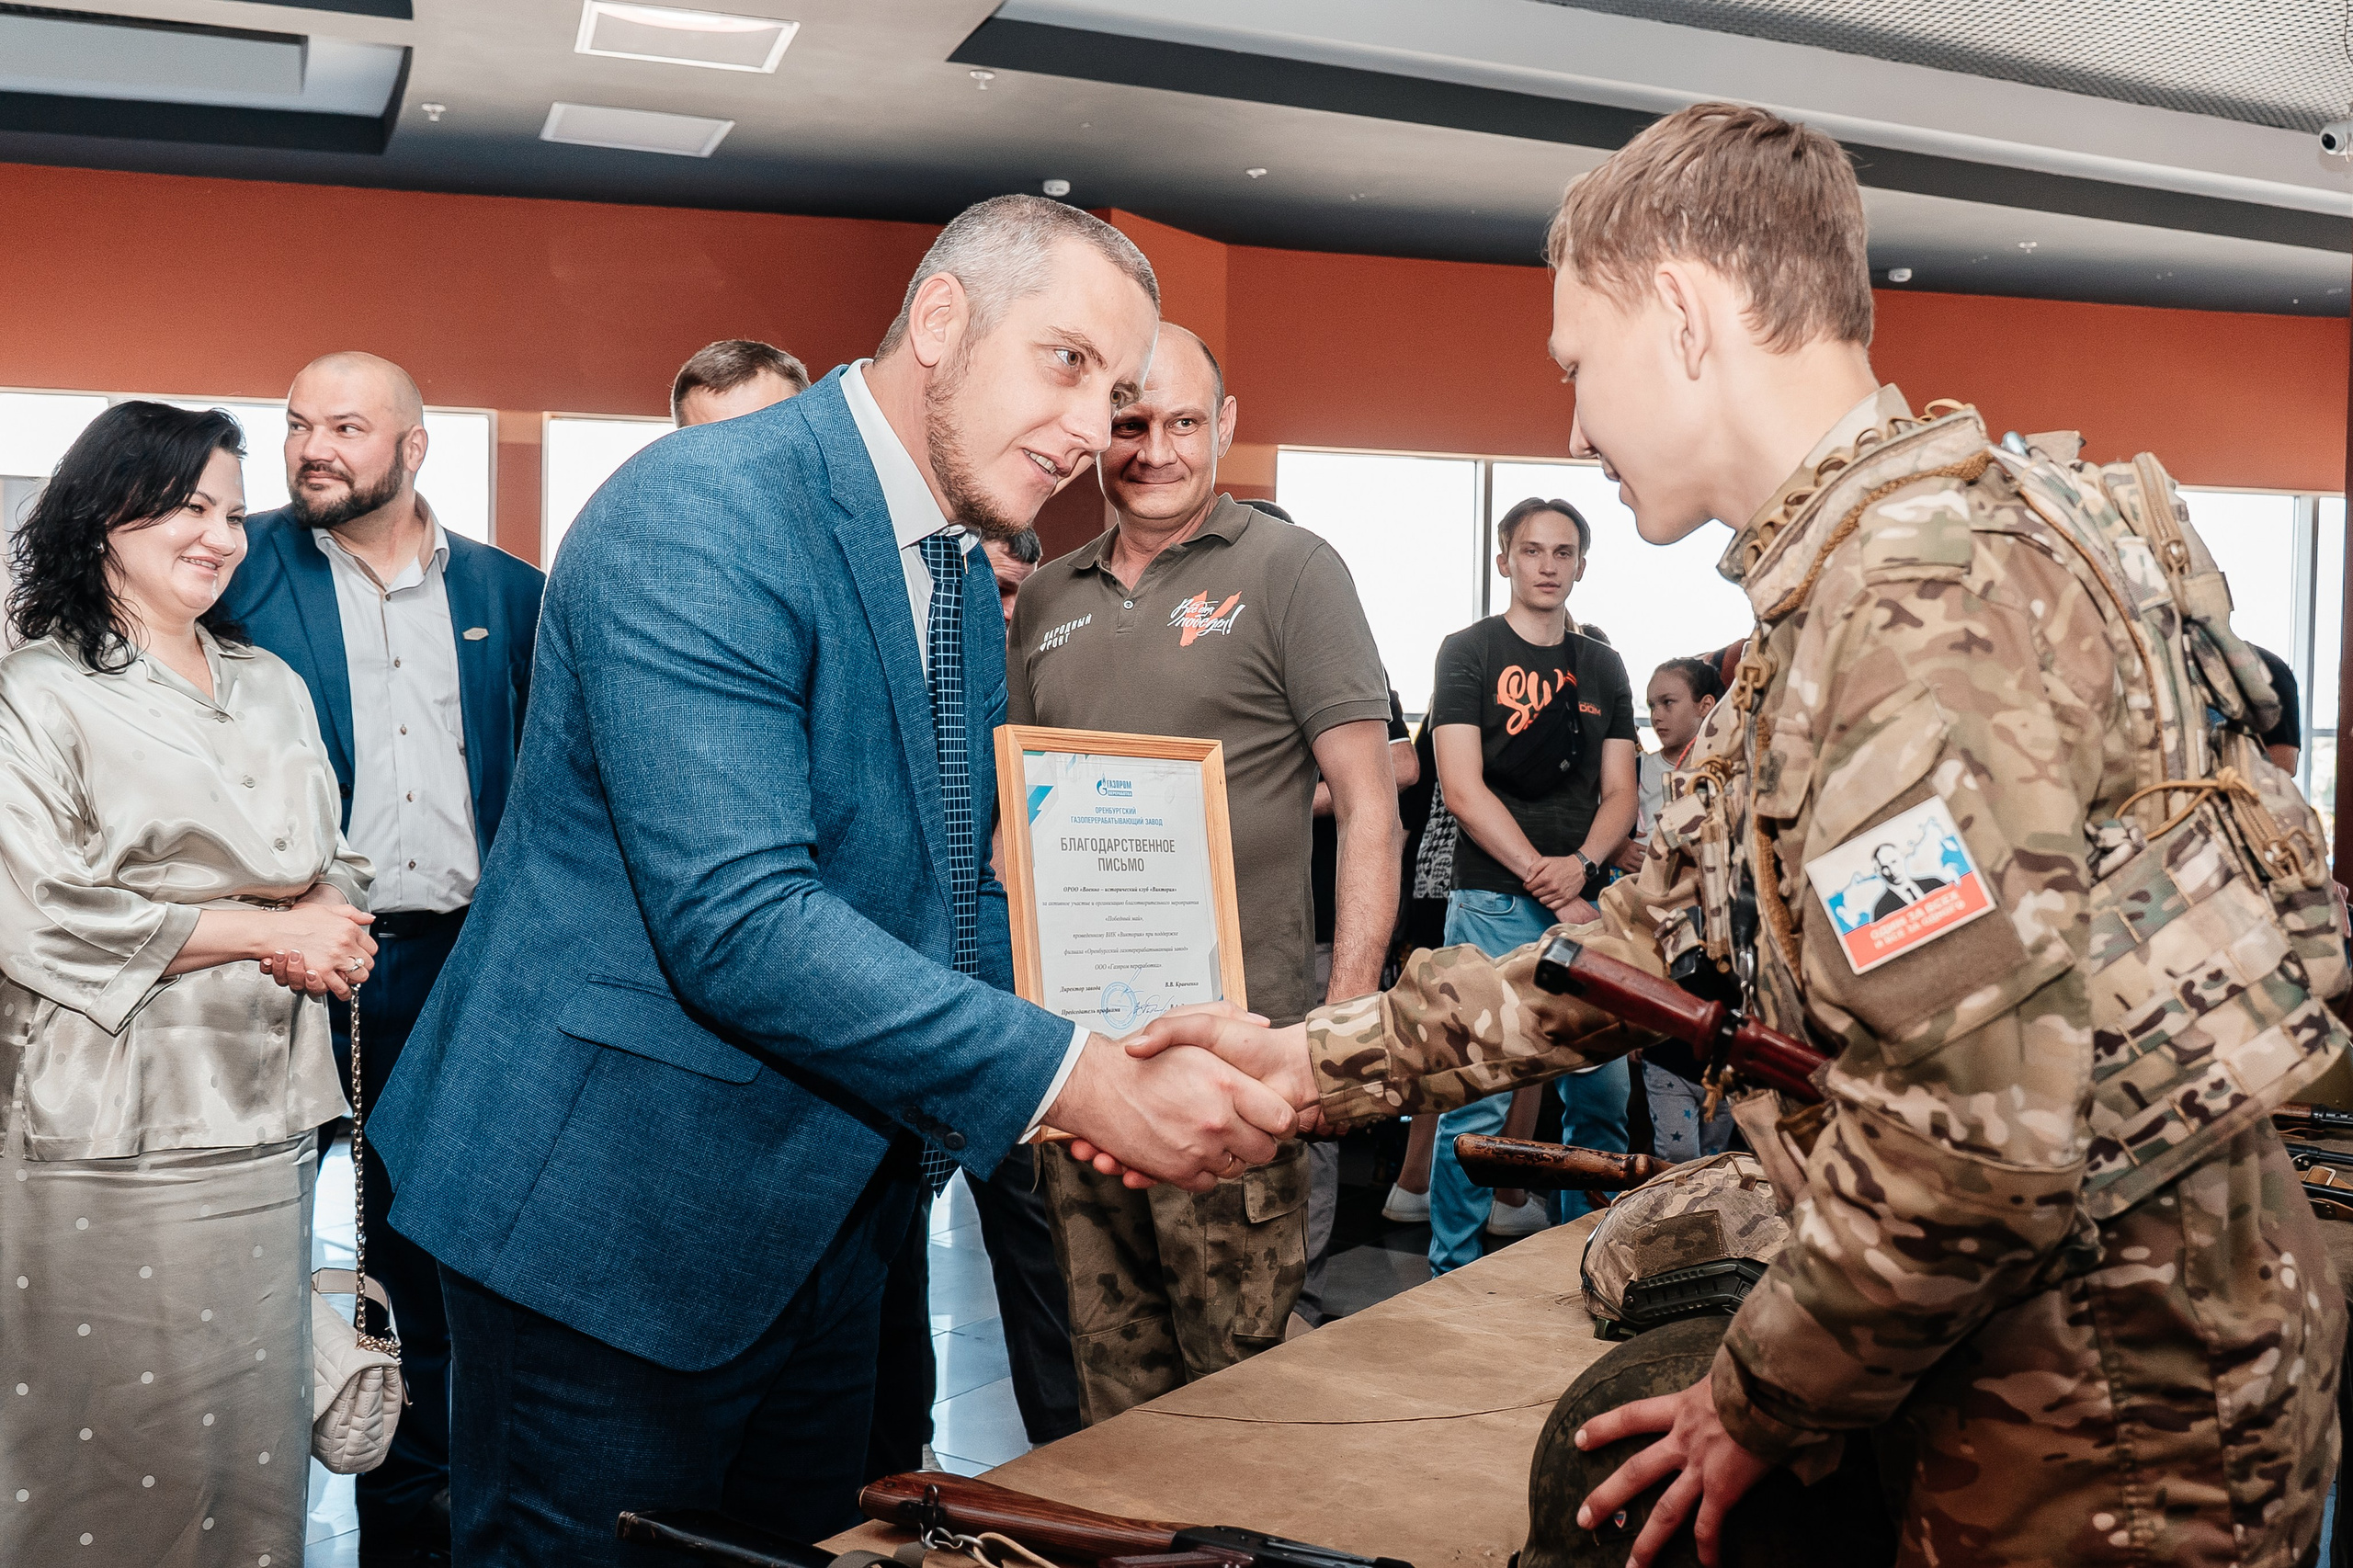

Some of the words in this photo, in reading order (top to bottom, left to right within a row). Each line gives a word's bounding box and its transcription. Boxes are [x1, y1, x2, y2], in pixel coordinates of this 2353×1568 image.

[1043, 613, 1092, 642] НАРОДНЫЙ
[1040, 632, 1070, 652] ФРОНТ
[1107, 779, 1132, 789] ГАЗПРОМ
[1095, 806, 1137, 815] ОРЕНБУРГСКИЙ
[1071, 816, 1144, 825] ГАЗОПЕРЕРАБАТЫВАЮЩИЙ
[1144, 818, 1164, 826] ЗАВОД
[1060, 837, 1176, 854] БЛАГОДАРСТВЕННОЕ
[1097, 858, 1145, 872] ПИСЬМО
